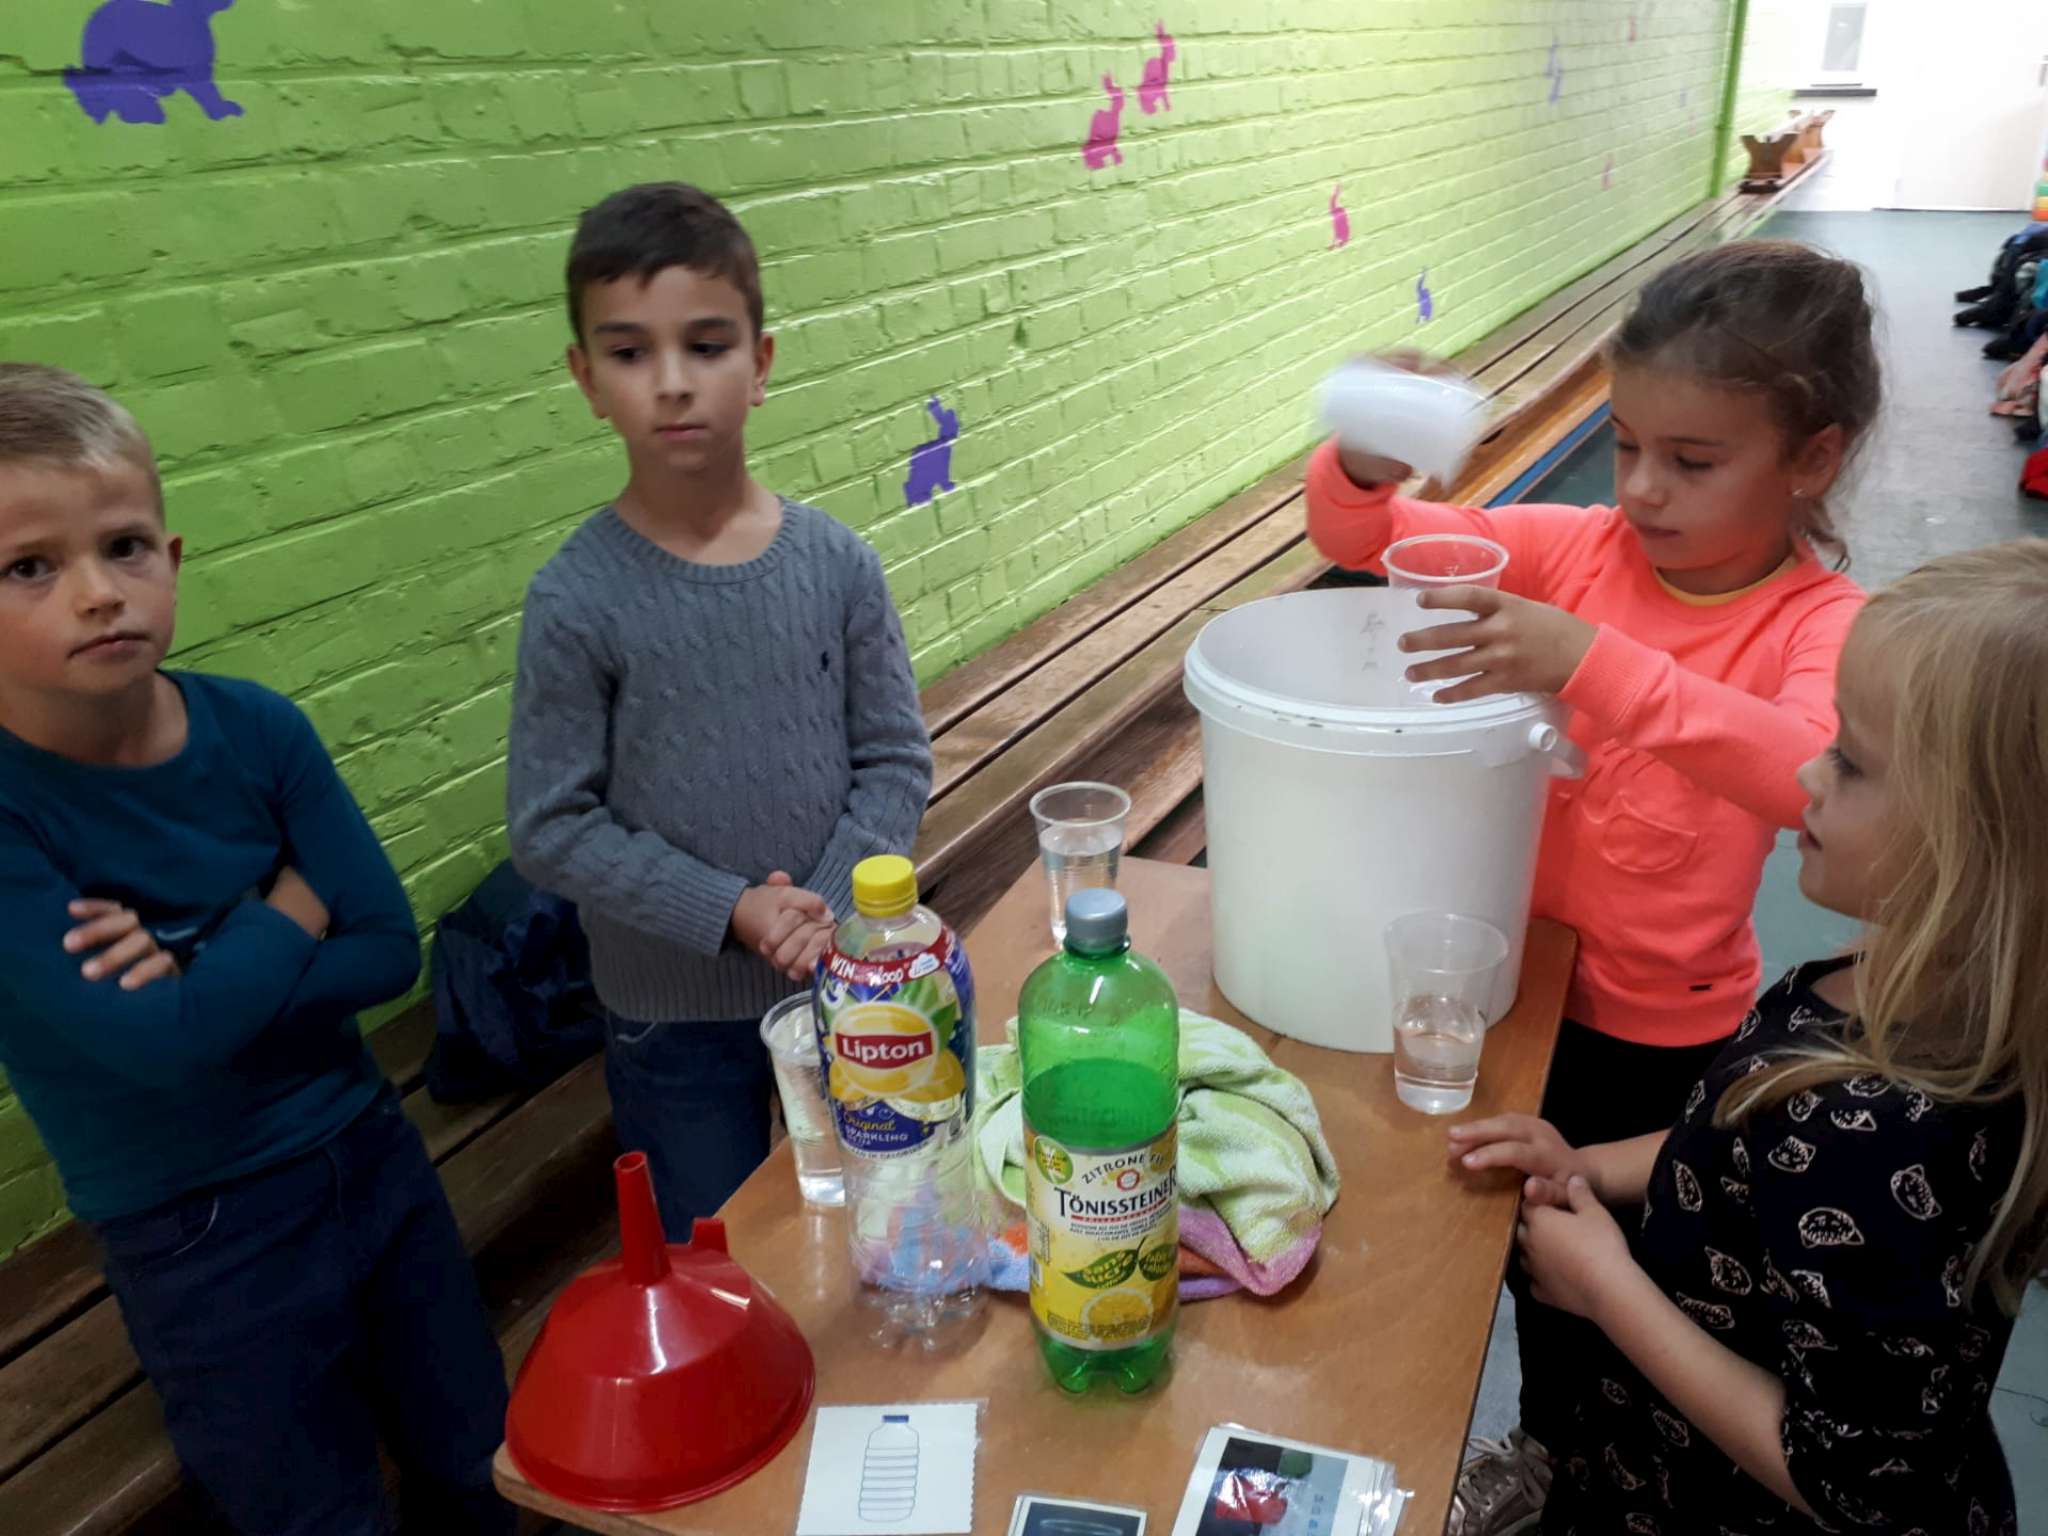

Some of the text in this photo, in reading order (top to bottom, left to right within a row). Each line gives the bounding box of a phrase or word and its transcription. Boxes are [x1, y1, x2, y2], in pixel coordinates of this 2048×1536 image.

[831, 954, 856, 978] WIN
[842, 1037, 925, 1064] Lipton
[1082, 1153, 1145, 1185] ZITRONE
[1054, 1164, 1178, 1218] TÖNISSTEINER
